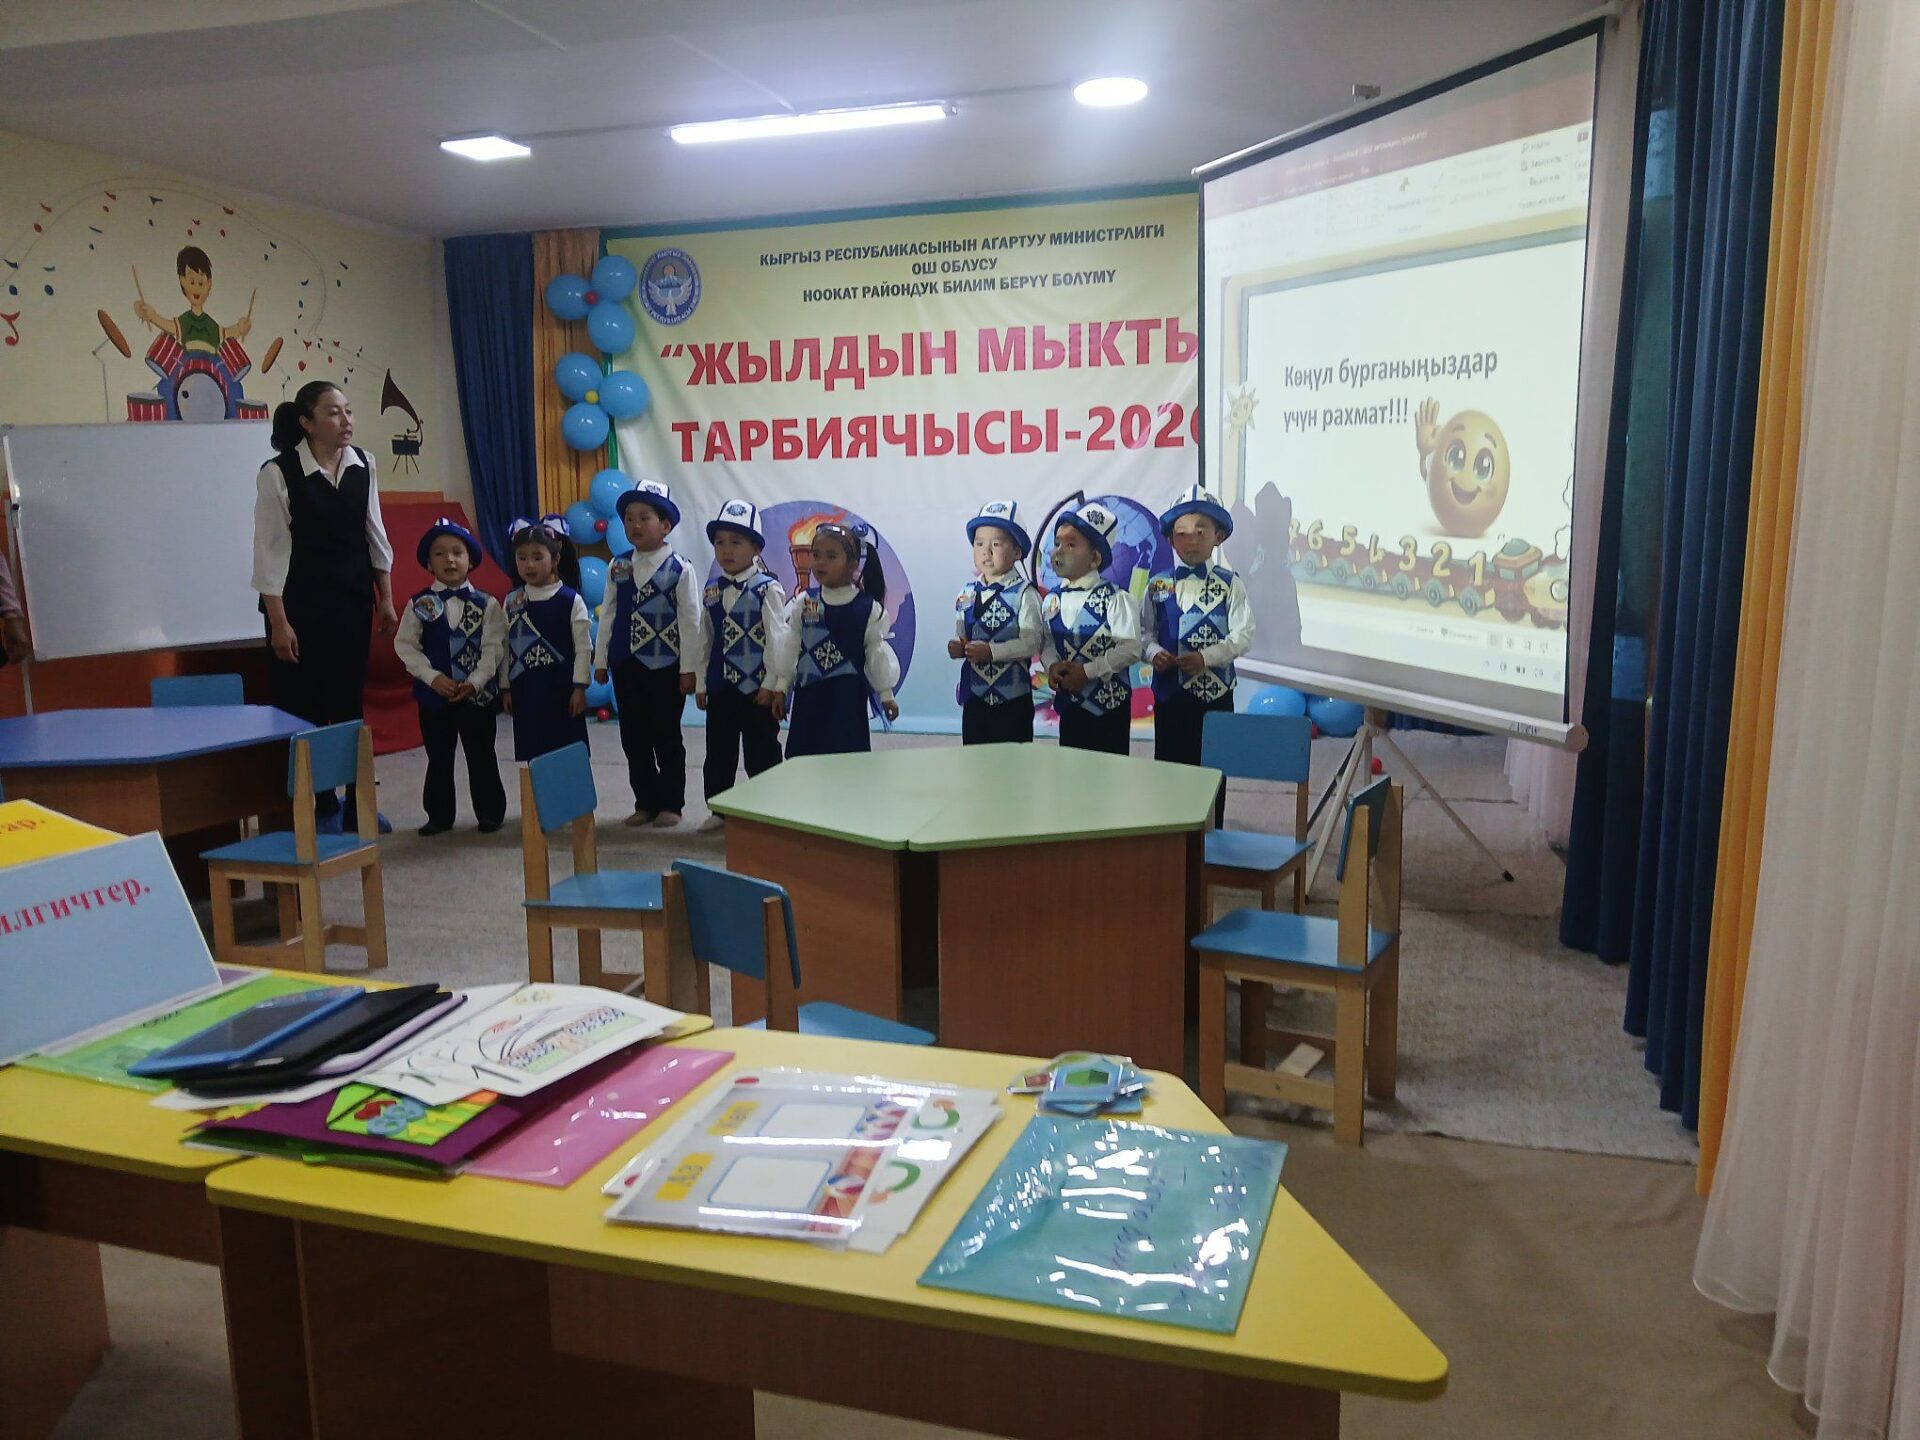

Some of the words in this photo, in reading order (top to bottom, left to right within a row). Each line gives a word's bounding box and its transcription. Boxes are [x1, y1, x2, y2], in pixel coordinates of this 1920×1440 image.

[759, 248, 822, 267] КЫРГЫЗ
[825, 237, 978, 262] РЕСПУБЛИКАСЫНЫН
[981, 233, 1047, 251] АГАРТУУ
[1050, 223, 1166, 246] МИНИСТРЛИГИ
[911, 261, 938, 276] ОШ
[941, 257, 998, 274] ОБЛУСУ
[803, 286, 859, 303] НООКАТ
[862, 280, 940, 299] РАЙОНДУК
[943, 277, 996, 294] БИЛИМ
[1284, 362, 1333, 391] Көңүл
[1338, 351, 1499, 384] бурганыңыздар
[1283, 408, 1318, 433] үчүн
[1322, 397, 1409, 430] рахмат!!!
[1307, 519, 1323, 550] 6
[1398, 534, 1418, 571] 3
[1431, 540, 1452, 577] 2
[1468, 550, 1487, 586] 1
